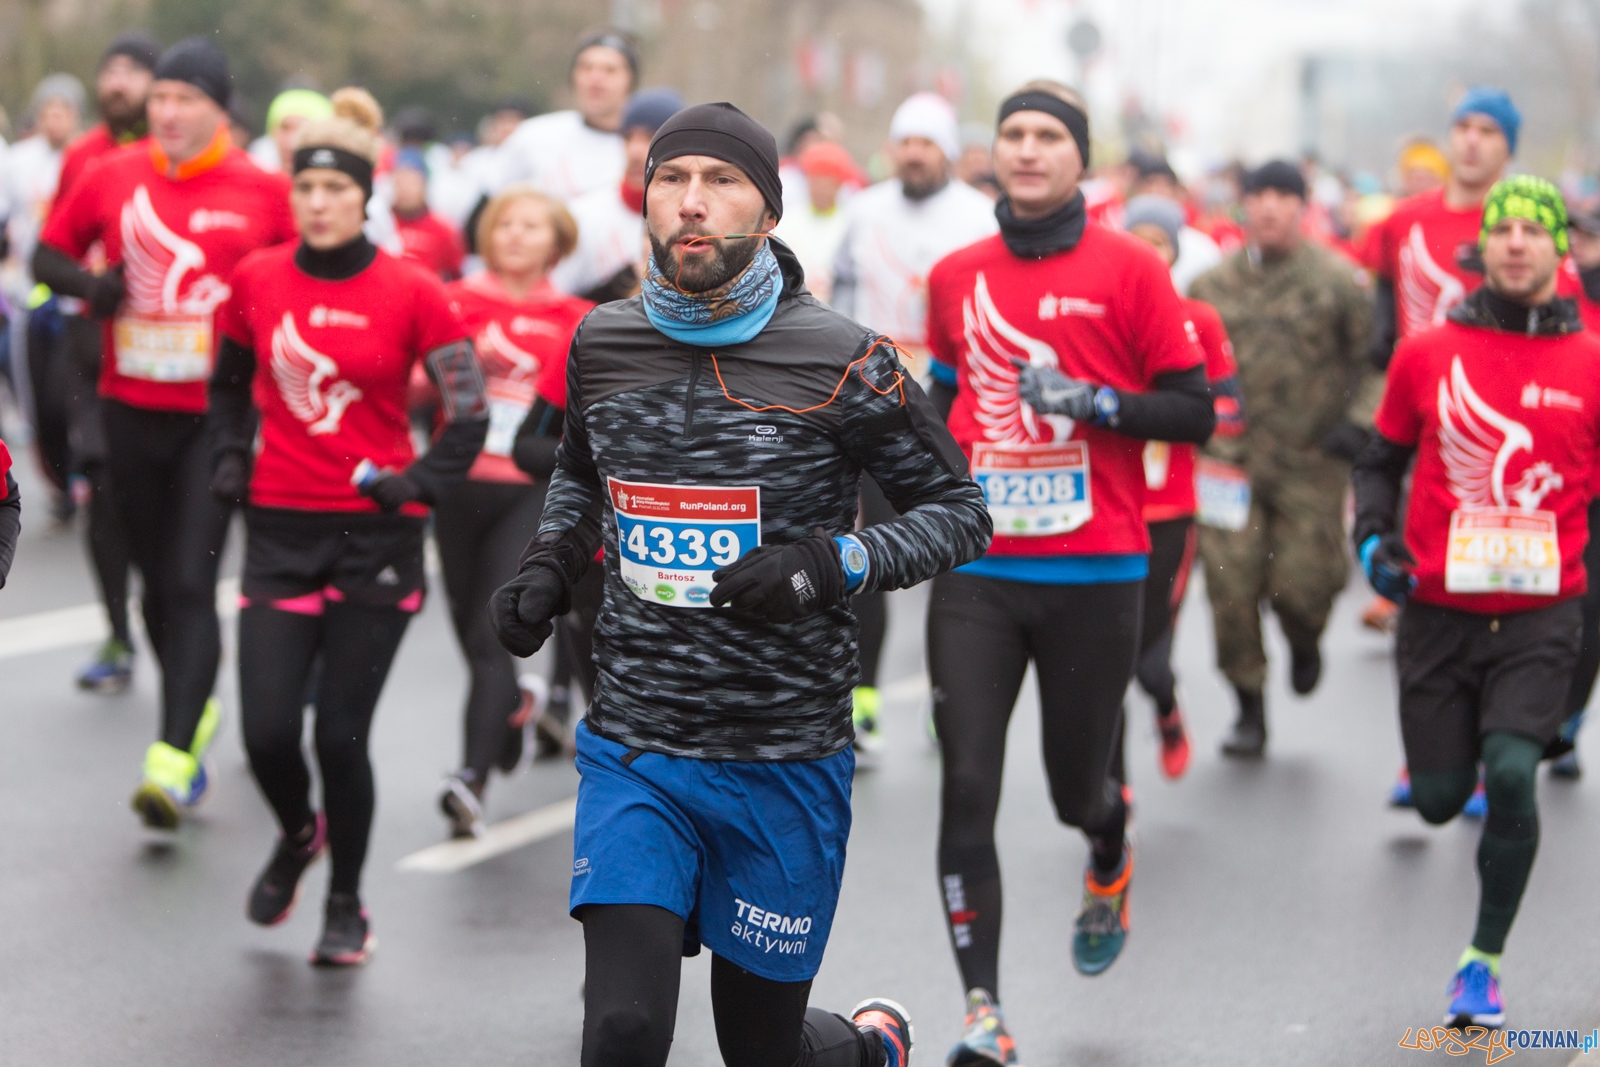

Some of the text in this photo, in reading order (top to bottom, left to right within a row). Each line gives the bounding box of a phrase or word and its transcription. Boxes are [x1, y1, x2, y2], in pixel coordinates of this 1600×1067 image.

[748, 434, 785, 443] Kalenji
[985, 472, 1076, 504] 9208
[679, 501, 747, 513] RunPoland.org
[627, 524, 740, 567] 4339
[656, 571, 696, 582] Bartosz
[734, 898, 812, 935] TERMO
[731, 920, 808, 955] aktywni
